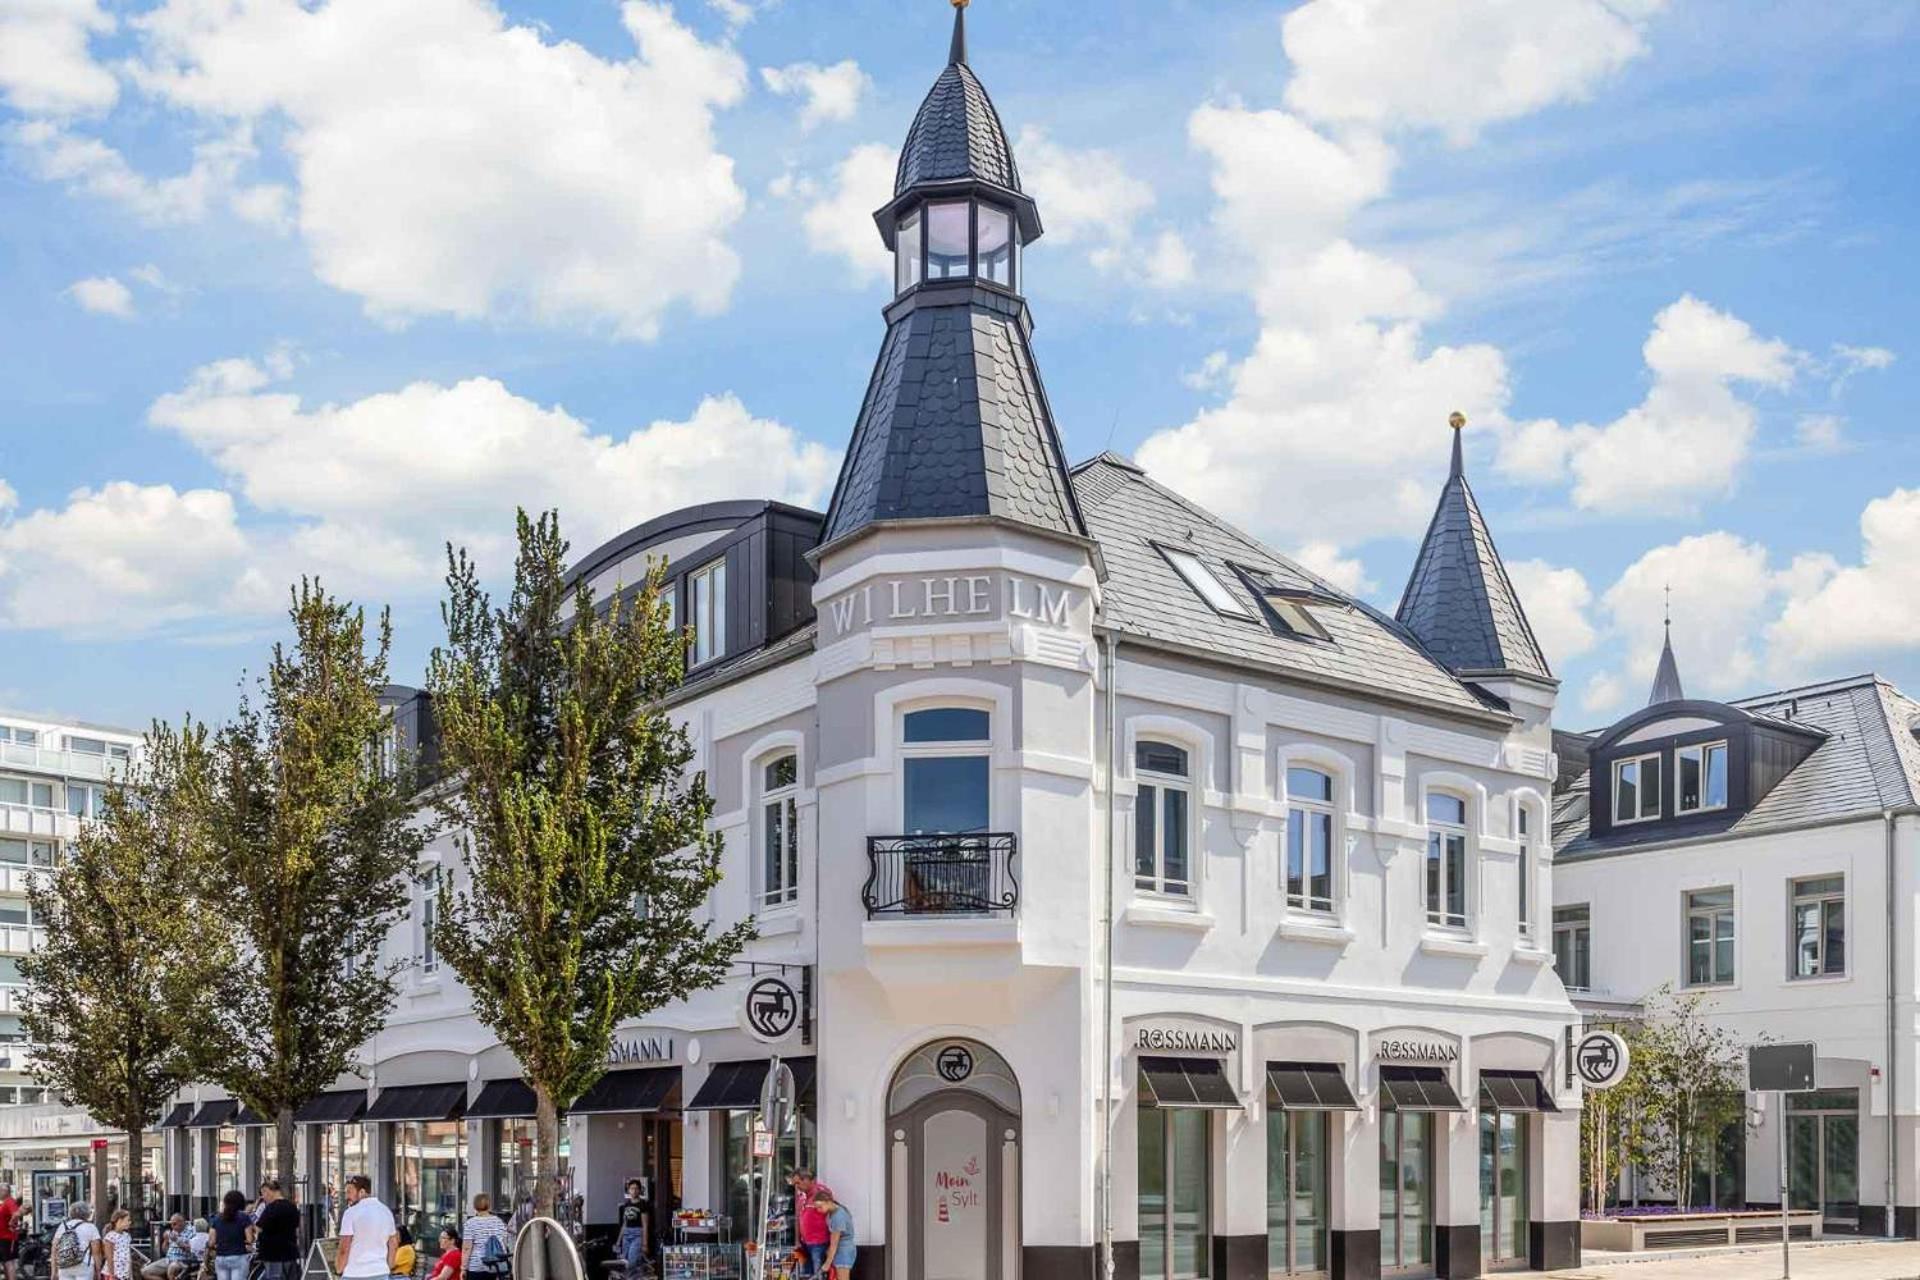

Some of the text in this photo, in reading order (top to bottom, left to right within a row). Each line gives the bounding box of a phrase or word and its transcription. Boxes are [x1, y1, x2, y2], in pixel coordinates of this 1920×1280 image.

[830, 576, 1072, 636] WILHELM
[1139, 1029, 1236, 1051] ROSSMANN
[1381, 1040, 1459, 1060] ROSSMANN
[952, 1190, 977, 1208] Sylt
